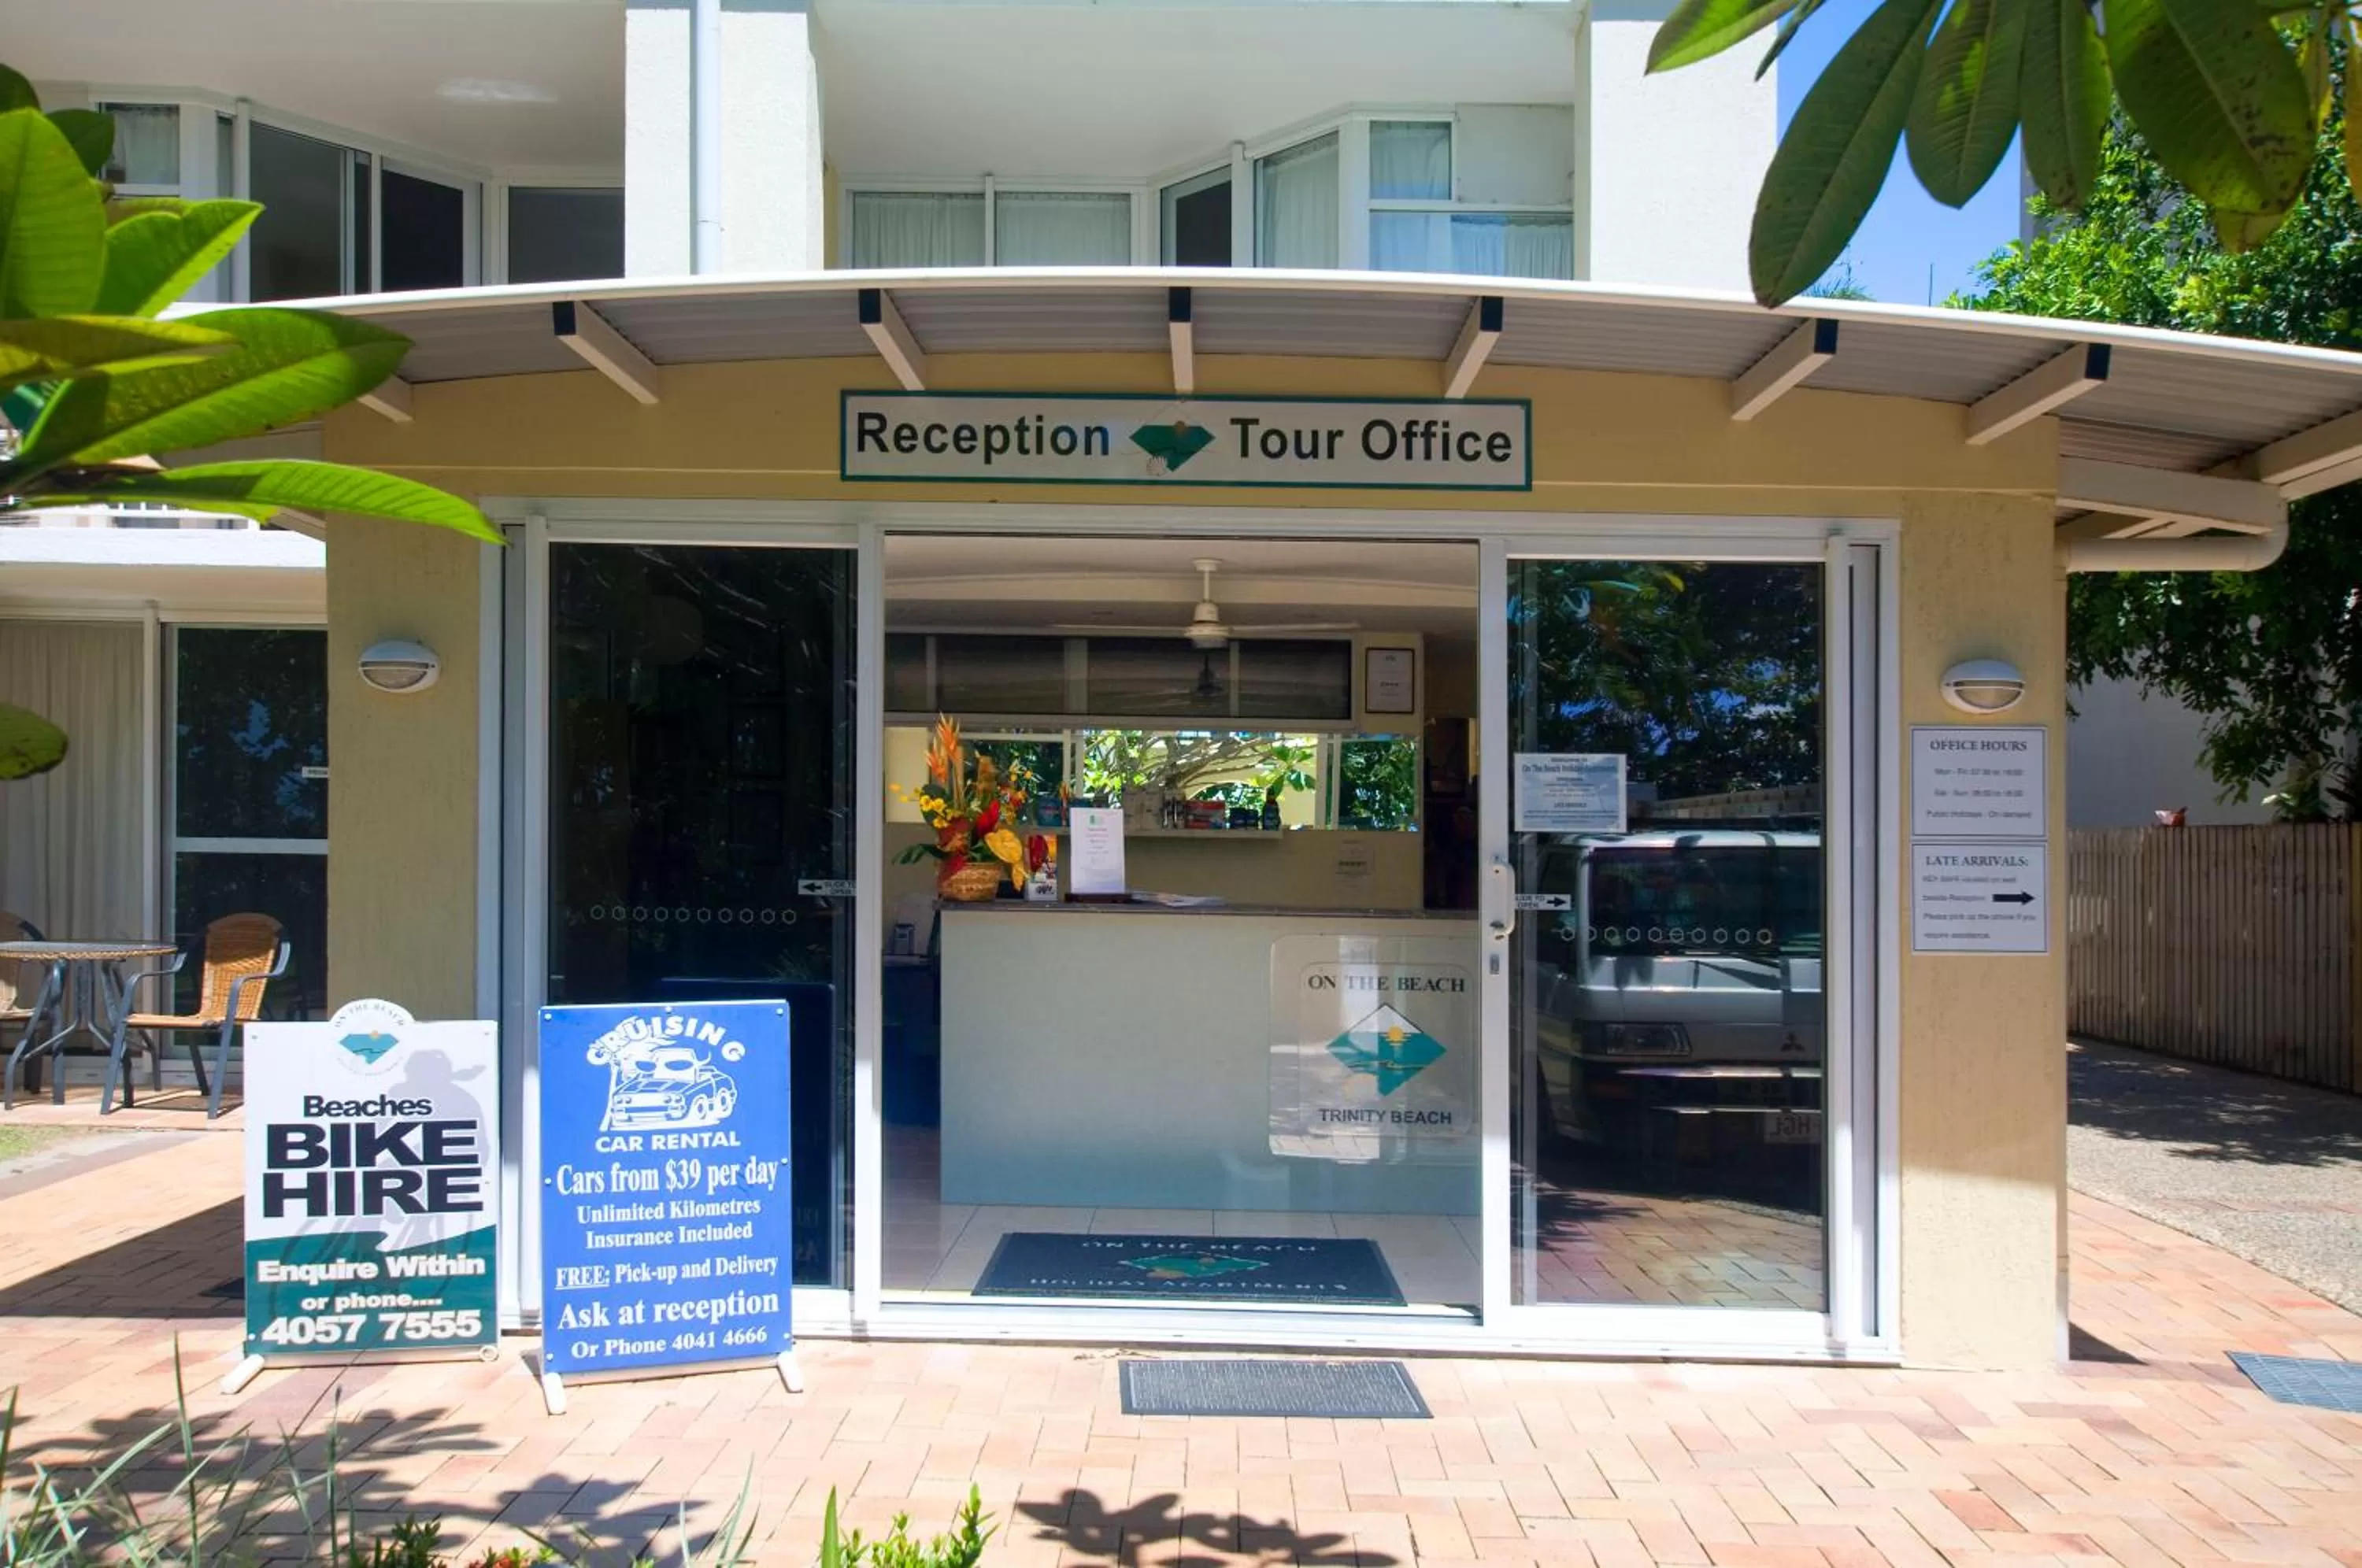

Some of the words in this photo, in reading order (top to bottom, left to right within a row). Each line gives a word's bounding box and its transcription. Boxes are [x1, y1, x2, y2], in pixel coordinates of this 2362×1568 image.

[856, 411, 1110, 464] Reception
[1230, 417, 1343, 461] Tour
[1361, 419, 1512, 463] Office
[1929, 740, 1979, 752] OFFICE
[1980, 740, 2028, 753] HOURS
[1926, 856, 1960, 867] LATE
[1308, 974, 1337, 990] ON
[1346, 975, 1390, 991] THE
[1398, 977, 1465, 993] BEACH
[586, 1015, 746, 1066] CRUISING
[303, 1094, 432, 1117] Beaches
[1319, 1108, 1386, 1123] TRINITY
[1390, 1110, 1452, 1125] BEACH
[266, 1119, 479, 1169] BIKE
[595, 1136, 643, 1152] CAR
[651, 1130, 741, 1151] RENTAL
[557, 1163, 605, 1196] Cars
[610, 1161, 659, 1193] from
[665, 1157, 702, 1193] $39
[707, 1165, 741, 1196] per
[745, 1156, 779, 1191] day
[262, 1167, 483, 1218] HIRE
[576, 1203, 665, 1225] Unlimited
[669, 1198, 761, 1220] Kilometres
[585, 1229, 673, 1249] Insurance
[678, 1221, 753, 1244] Included
[257, 1259, 379, 1285] Enquire
[386, 1255, 486, 1278] Within
[554, 1266, 610, 1290] FREE:
[614, 1263, 678, 1286] Pick-up
[681, 1259, 711, 1279] and
[715, 1255, 779, 1281] Delivery
[301, 1296, 330, 1311] or
[557, 1302, 609, 1329] Ask
[617, 1300, 645, 1325] at
[653, 1290, 779, 1326] reception
[261, 1315, 367, 1345] 4057
[378, 1310, 482, 1341] 7555
[571, 1341, 598, 1359] Or
[603, 1336, 667, 1356] Phone
[672, 1330, 716, 1351] 4041
[723, 1327, 768, 1346] 4666
